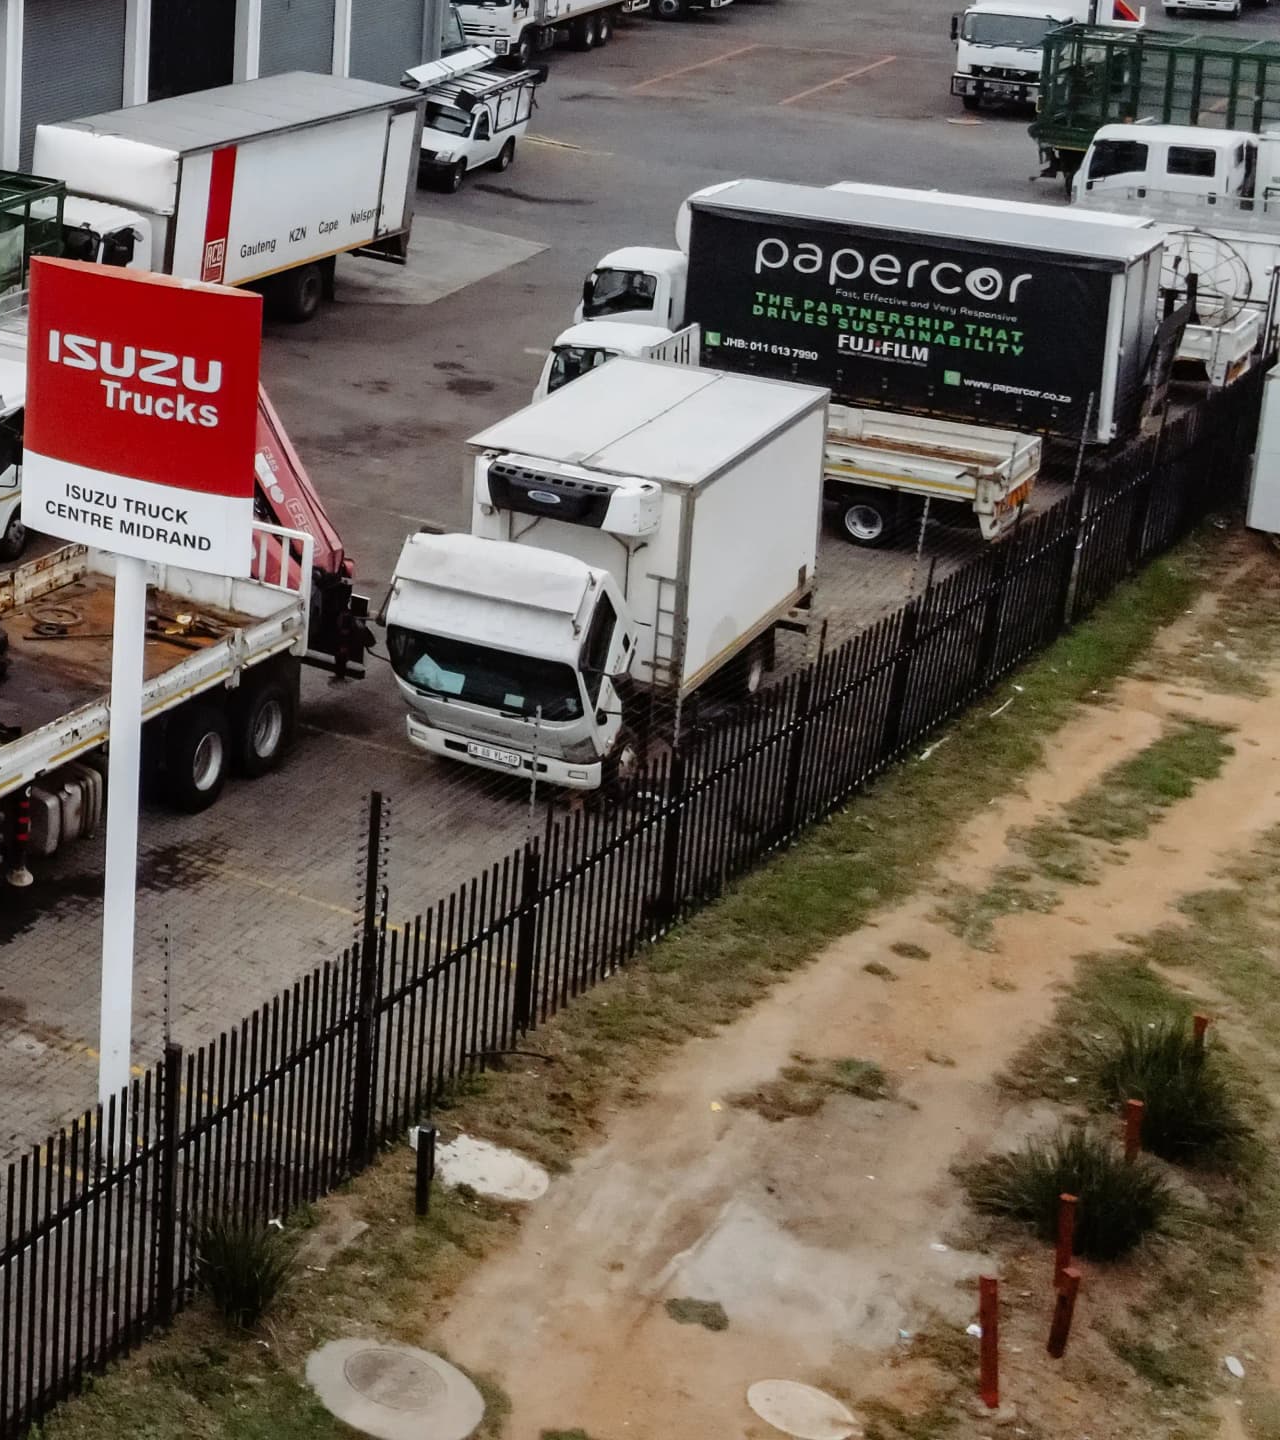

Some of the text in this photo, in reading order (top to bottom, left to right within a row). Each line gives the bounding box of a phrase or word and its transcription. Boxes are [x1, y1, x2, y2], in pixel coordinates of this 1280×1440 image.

[288, 226, 307, 244] KZN
[318, 218, 339, 235] Cape
[240, 239, 277, 259] Gauteng
[754, 237, 1033, 304] papercor
[755, 291, 1024, 343] THE PARTNERSHIP THAT
[835, 287, 1018, 323] Fast, Effective and Very Responsive
[722, 336, 819, 361] JHB: 011 613 7990
[752, 304, 1025, 357] DRIVES SUSTAINABILITY
[837, 333, 930, 362] FUJIFILM
[48, 328, 223, 394] ISUZU
[99, 378, 220, 429] Trucks
[963, 377, 1072, 404] www.papercor.co.za
[65, 483, 190, 525] ISUZU TRUCK
[45, 500, 212, 552] CENTRE MIDRAND
